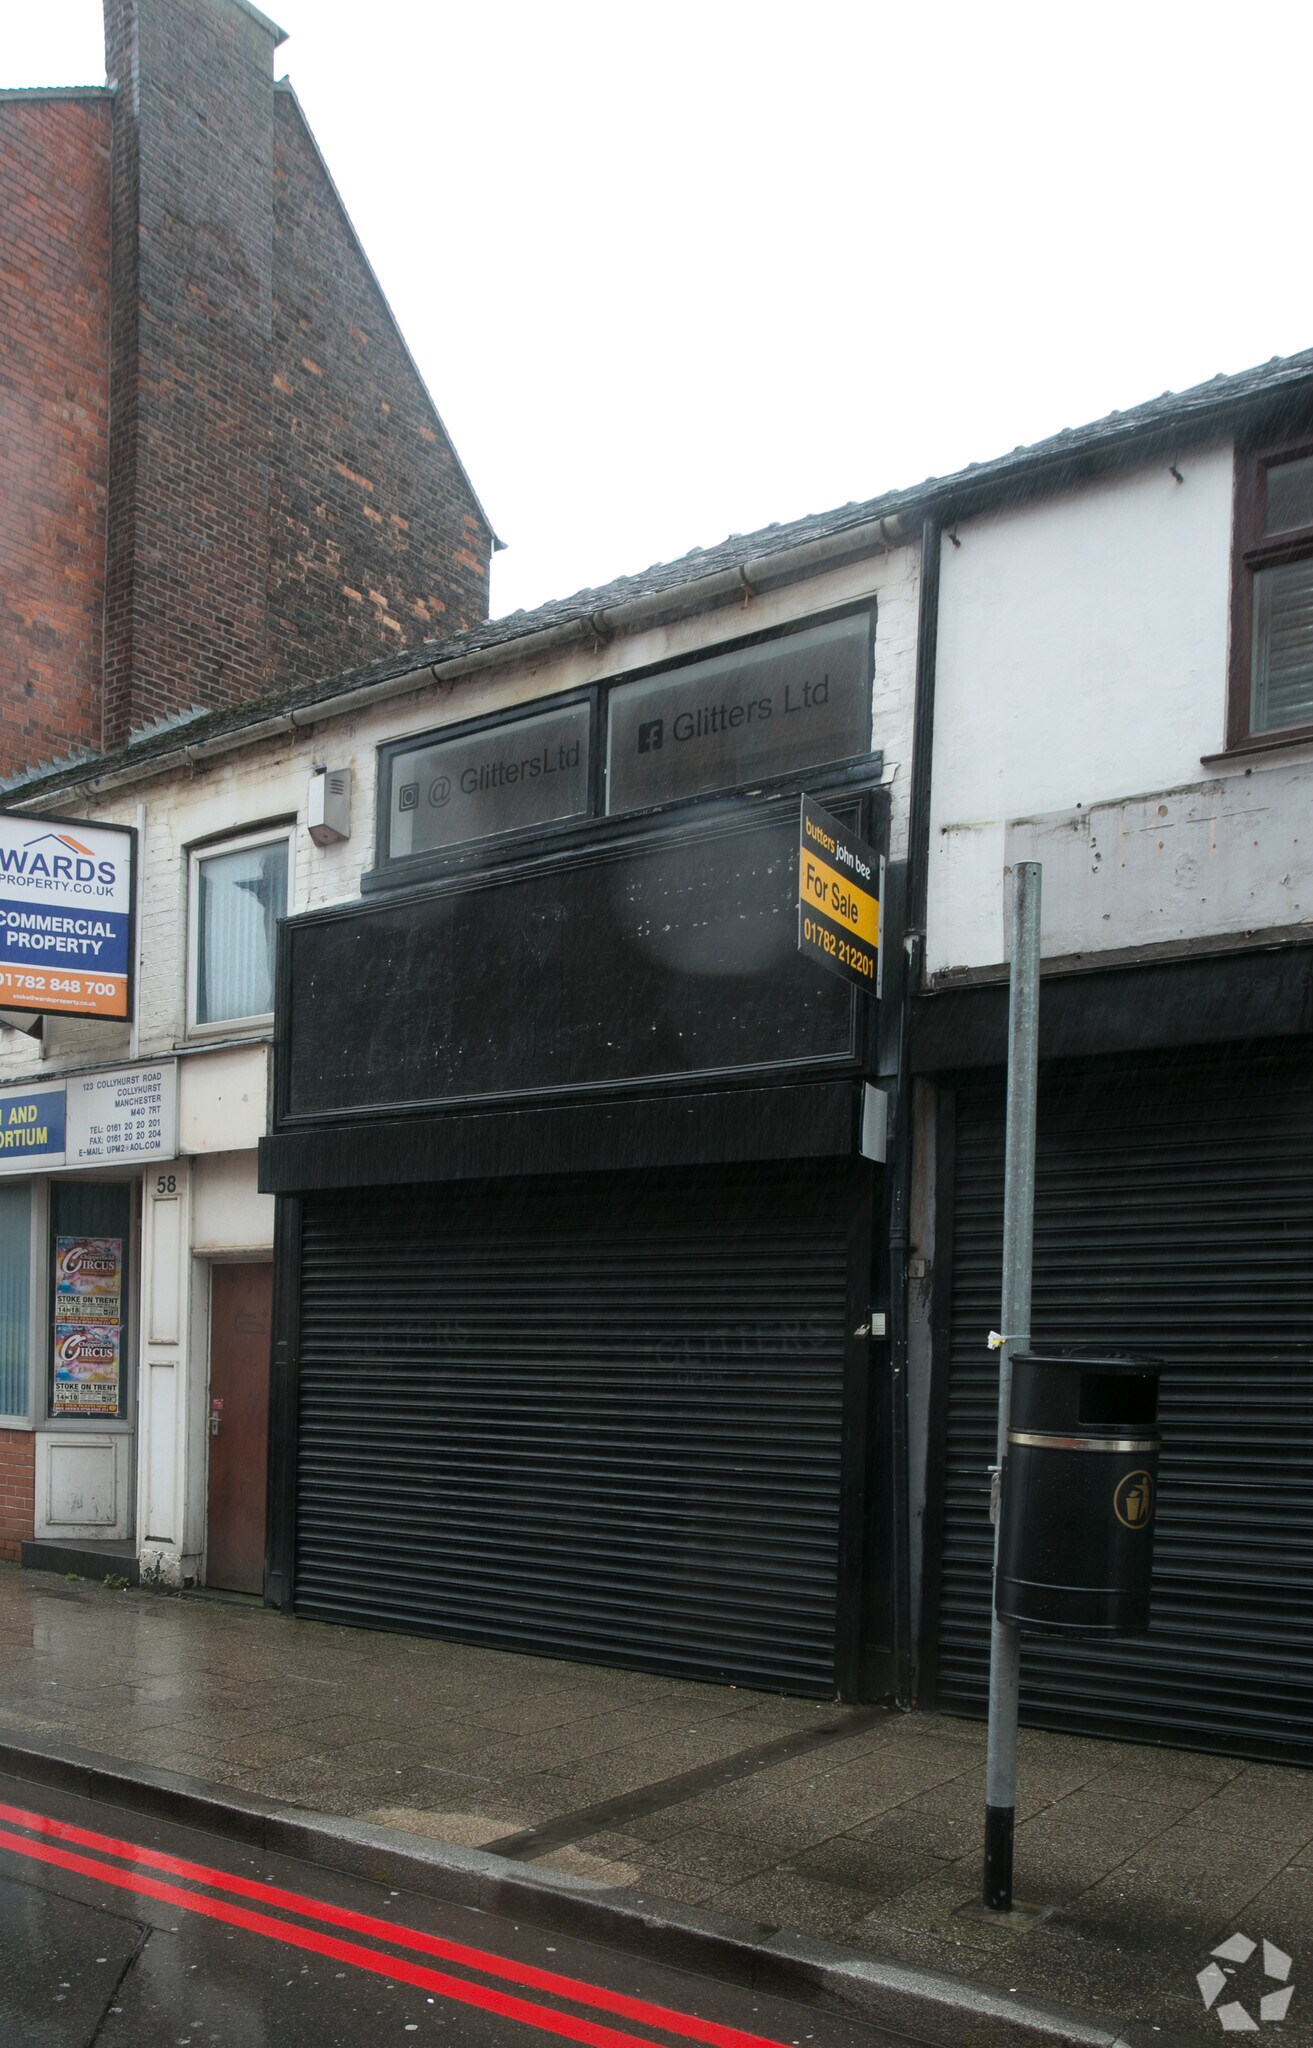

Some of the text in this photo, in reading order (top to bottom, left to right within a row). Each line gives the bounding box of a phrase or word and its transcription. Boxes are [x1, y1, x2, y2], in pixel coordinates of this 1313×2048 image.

[672, 695, 773, 743] Glitters
[783, 675, 830, 714] Ltd
[460, 740, 581, 795] GlittersLtd
[805, 816, 835, 854] butters
[835, 840, 854, 868] john
[855, 855, 871, 880] bee
[0, 847, 116, 885] WARDS
[806, 862, 859, 925] For Sale
[0, 909, 116, 938] COMMERCIAL
[6, 931, 103, 955] PROPERTY
[803, 918, 875, 979] 01782 212201
[50, 978, 81, 993] 848
[85, 982, 116, 997] 700
[83, 1072, 162, 1092] 123 COLLYHURST ROAD
[117, 1083, 161, 1097] COLLYHURST
[115, 1094, 162, 1108] MANCHESTER
[130, 1105, 161, 1117] M40 7RT
[9, 1104, 38, 1125] AND
[106, 1122, 121, 1133] 0161
[124, 1121, 133, 1131] 20
[136, 1120, 145, 1130] 20
[148, 1118, 161, 1128] 201
[106, 1133, 121, 1144] 0161
[124, 1132, 133, 1142] 20
[136, 1130, 145, 1140] 20
[148, 1129, 161, 1139] 204
[156, 1174, 177, 1194] 58
[94, 1296, 119, 1304] TRENT
[81, 1383, 91, 1391] ON
